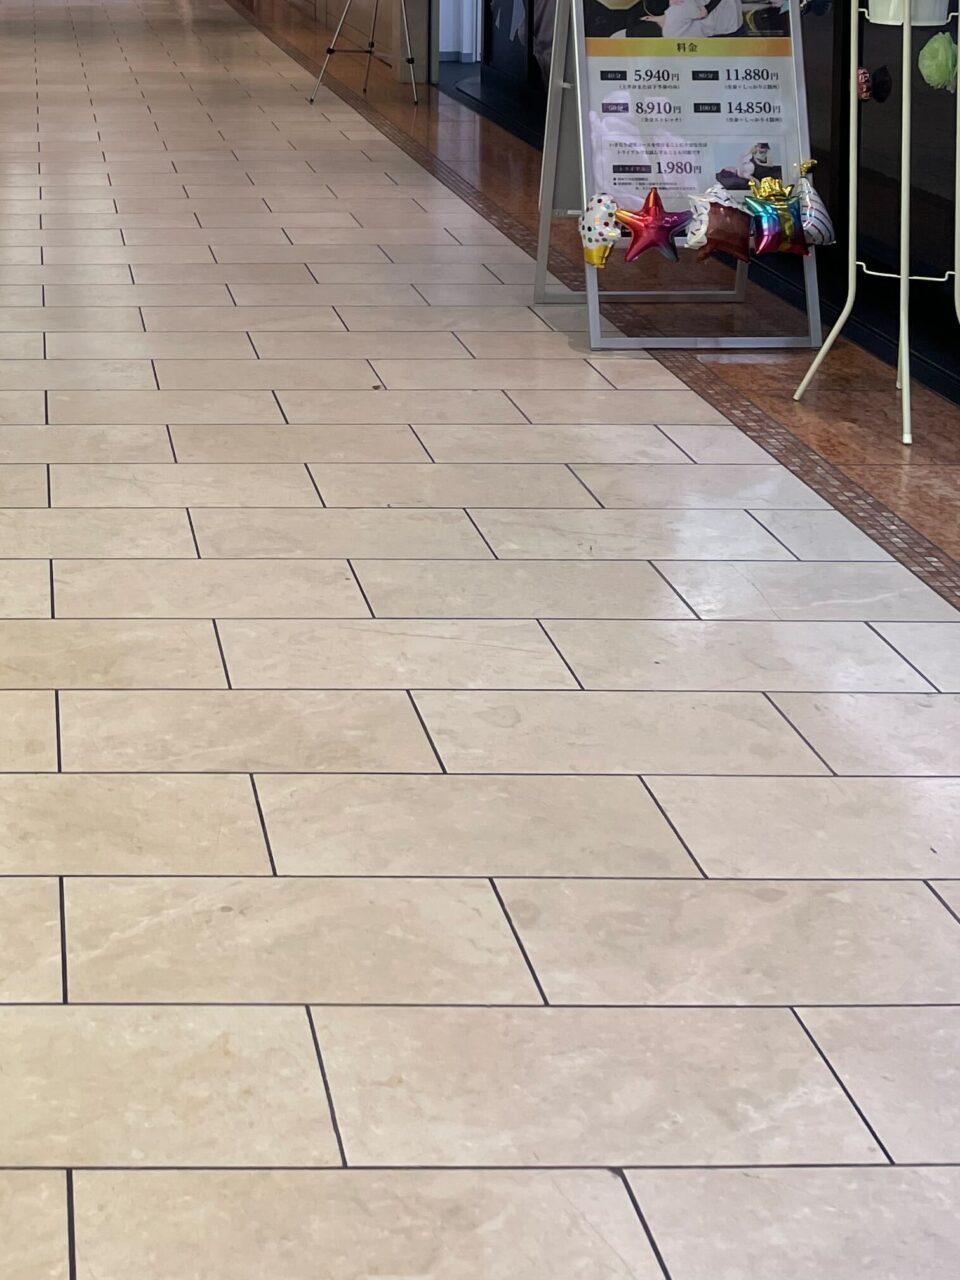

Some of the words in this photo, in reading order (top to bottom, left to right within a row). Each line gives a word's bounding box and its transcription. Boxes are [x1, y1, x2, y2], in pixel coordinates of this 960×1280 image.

[677, 42, 698, 53] 料金
[634, 69, 680, 82] 5,940円
[725, 68, 779, 82] 11,880円
[635, 101, 681, 114] 8,910円
[727, 100, 781, 114] 14,850円
[656, 161, 702, 174] 1,980円
